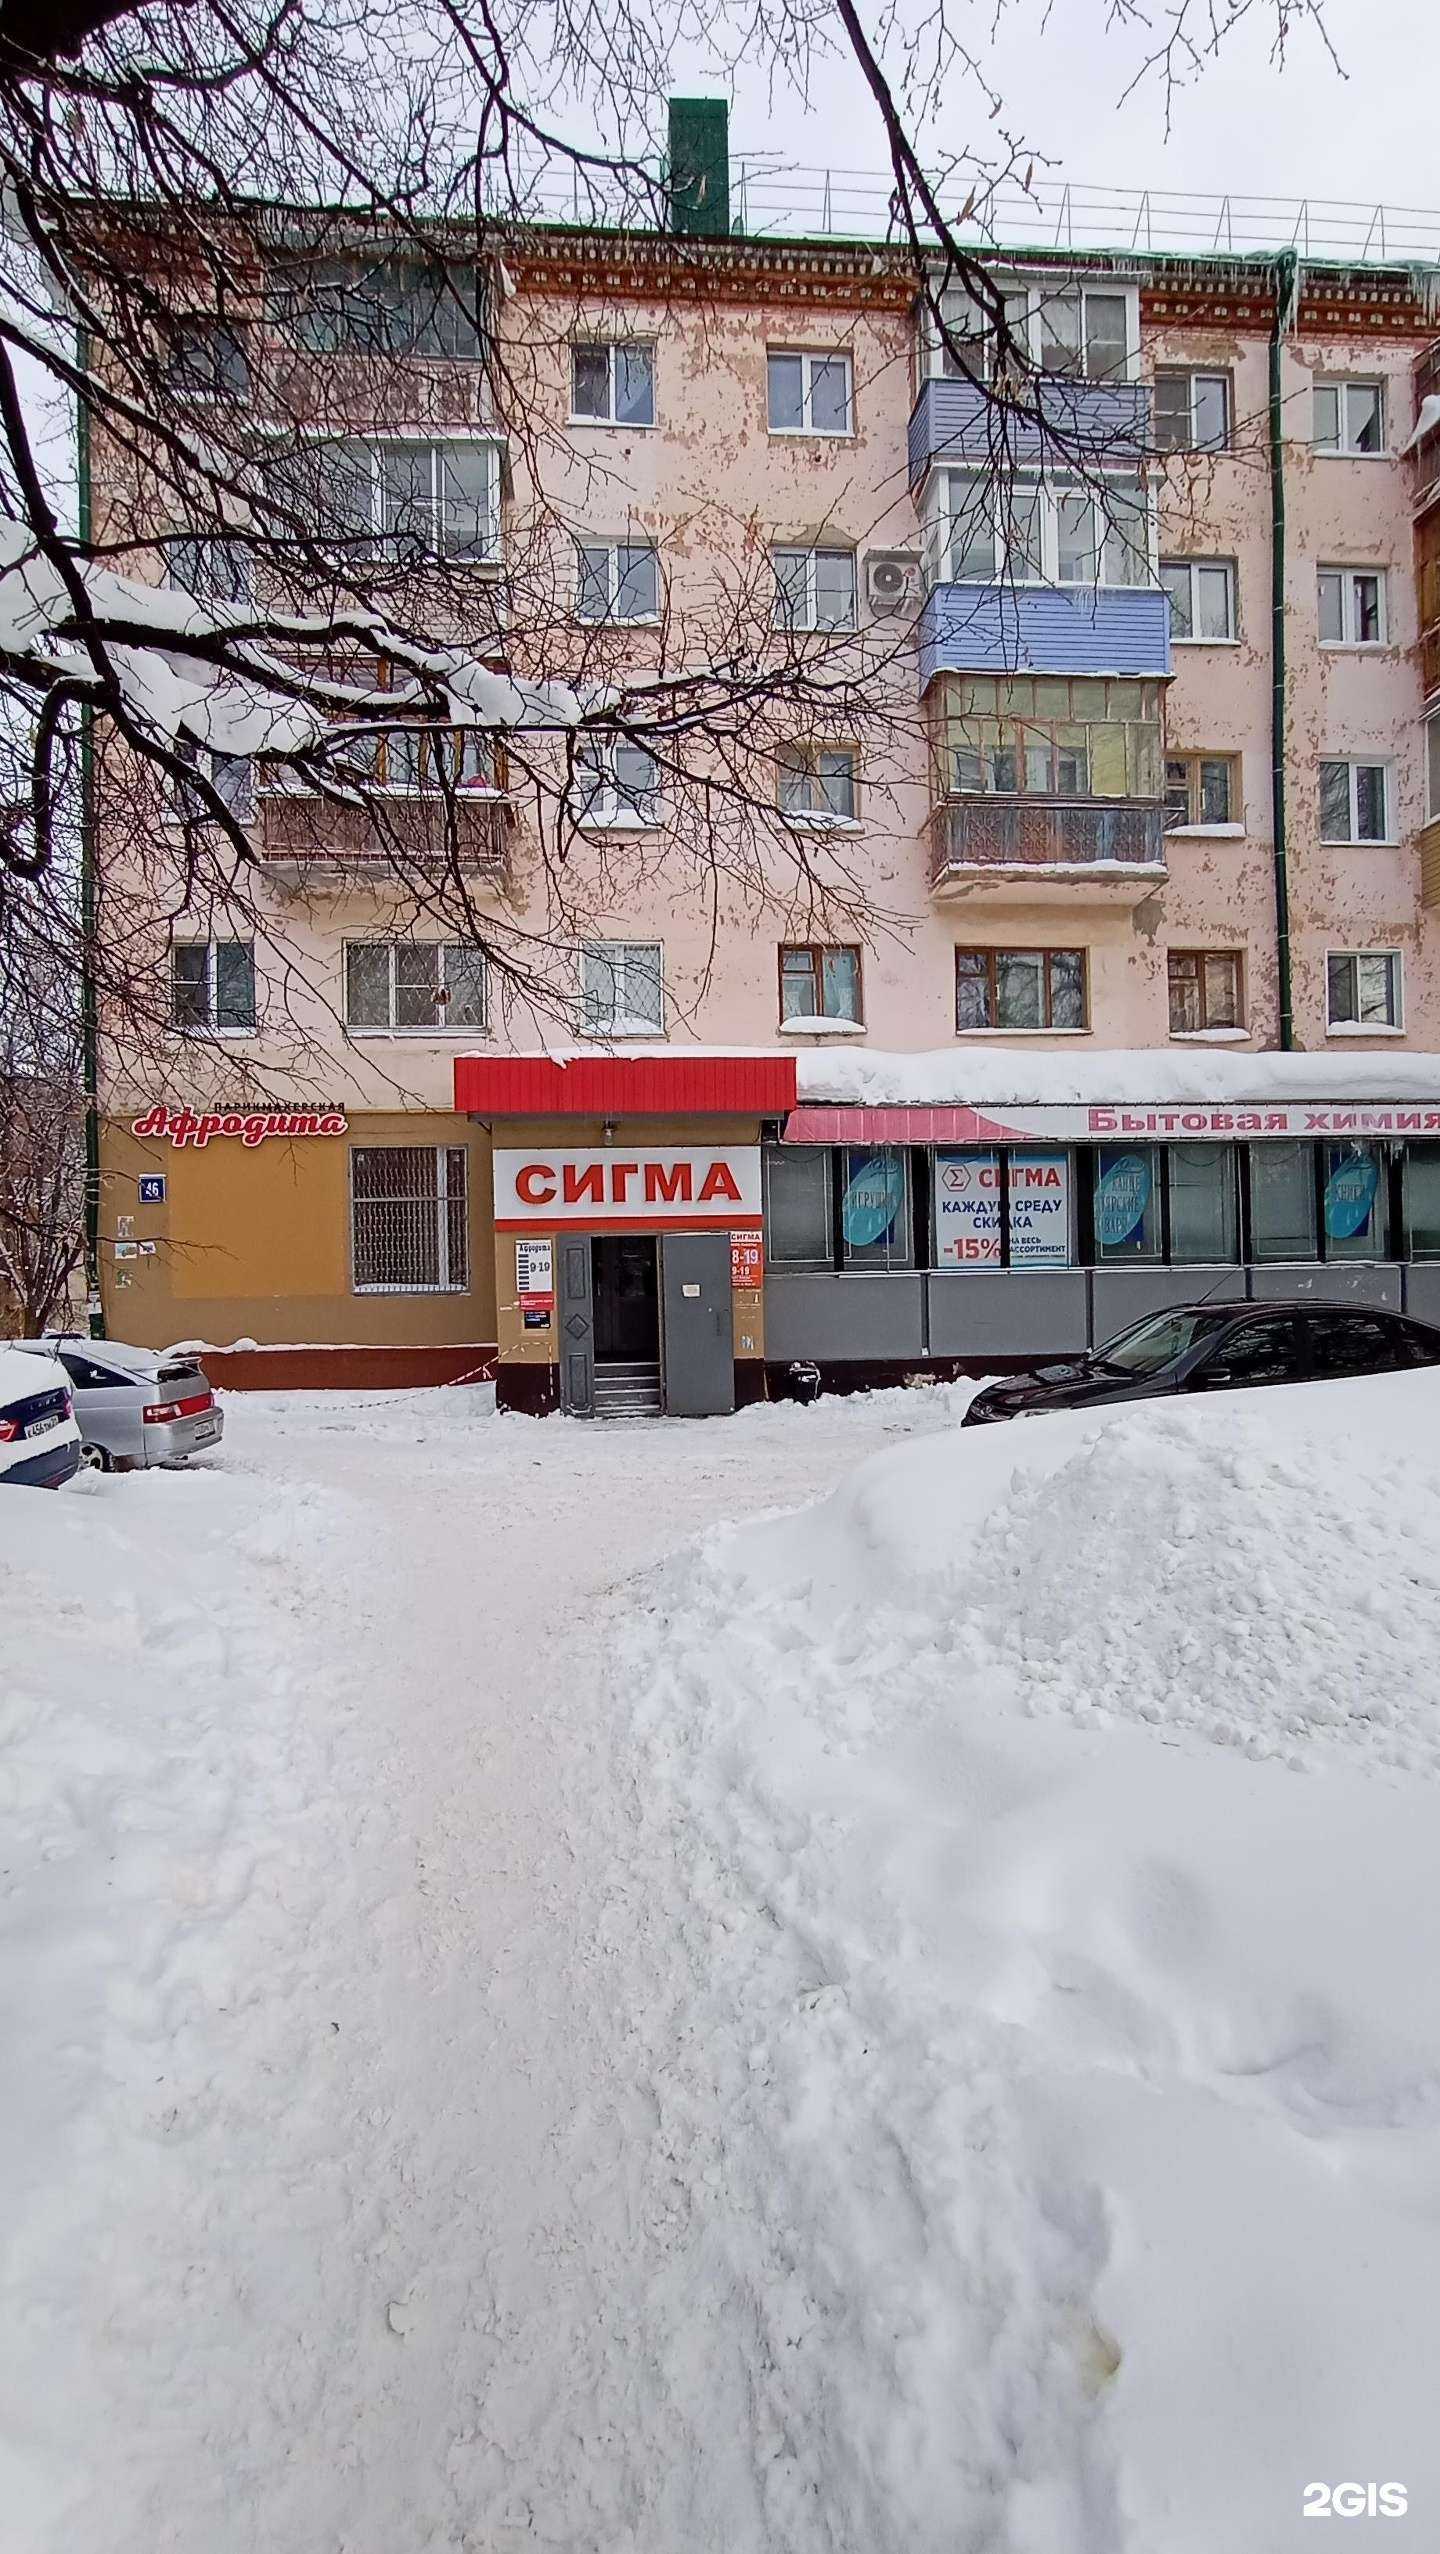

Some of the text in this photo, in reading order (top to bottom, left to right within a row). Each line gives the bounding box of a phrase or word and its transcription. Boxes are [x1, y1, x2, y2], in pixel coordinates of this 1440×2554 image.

[214, 1103, 345, 1112] ПАРИКМАХЕРСКАЯ
[133, 1105, 347, 1147] Афродита
[1088, 1108, 1440, 1131] Бытовая химия
[145, 1181, 160, 1197] 46
[515, 1162, 743, 1204] СИГМА
[1015, 1200, 1062, 1214] СРЕДУ
[972, 1217, 1033, 1229] СКИКА
[731, 1233, 760, 1241] СИГМА
[943, 1238, 1002, 1259] -15%
[732, 1249, 759, 1265] 8-19
